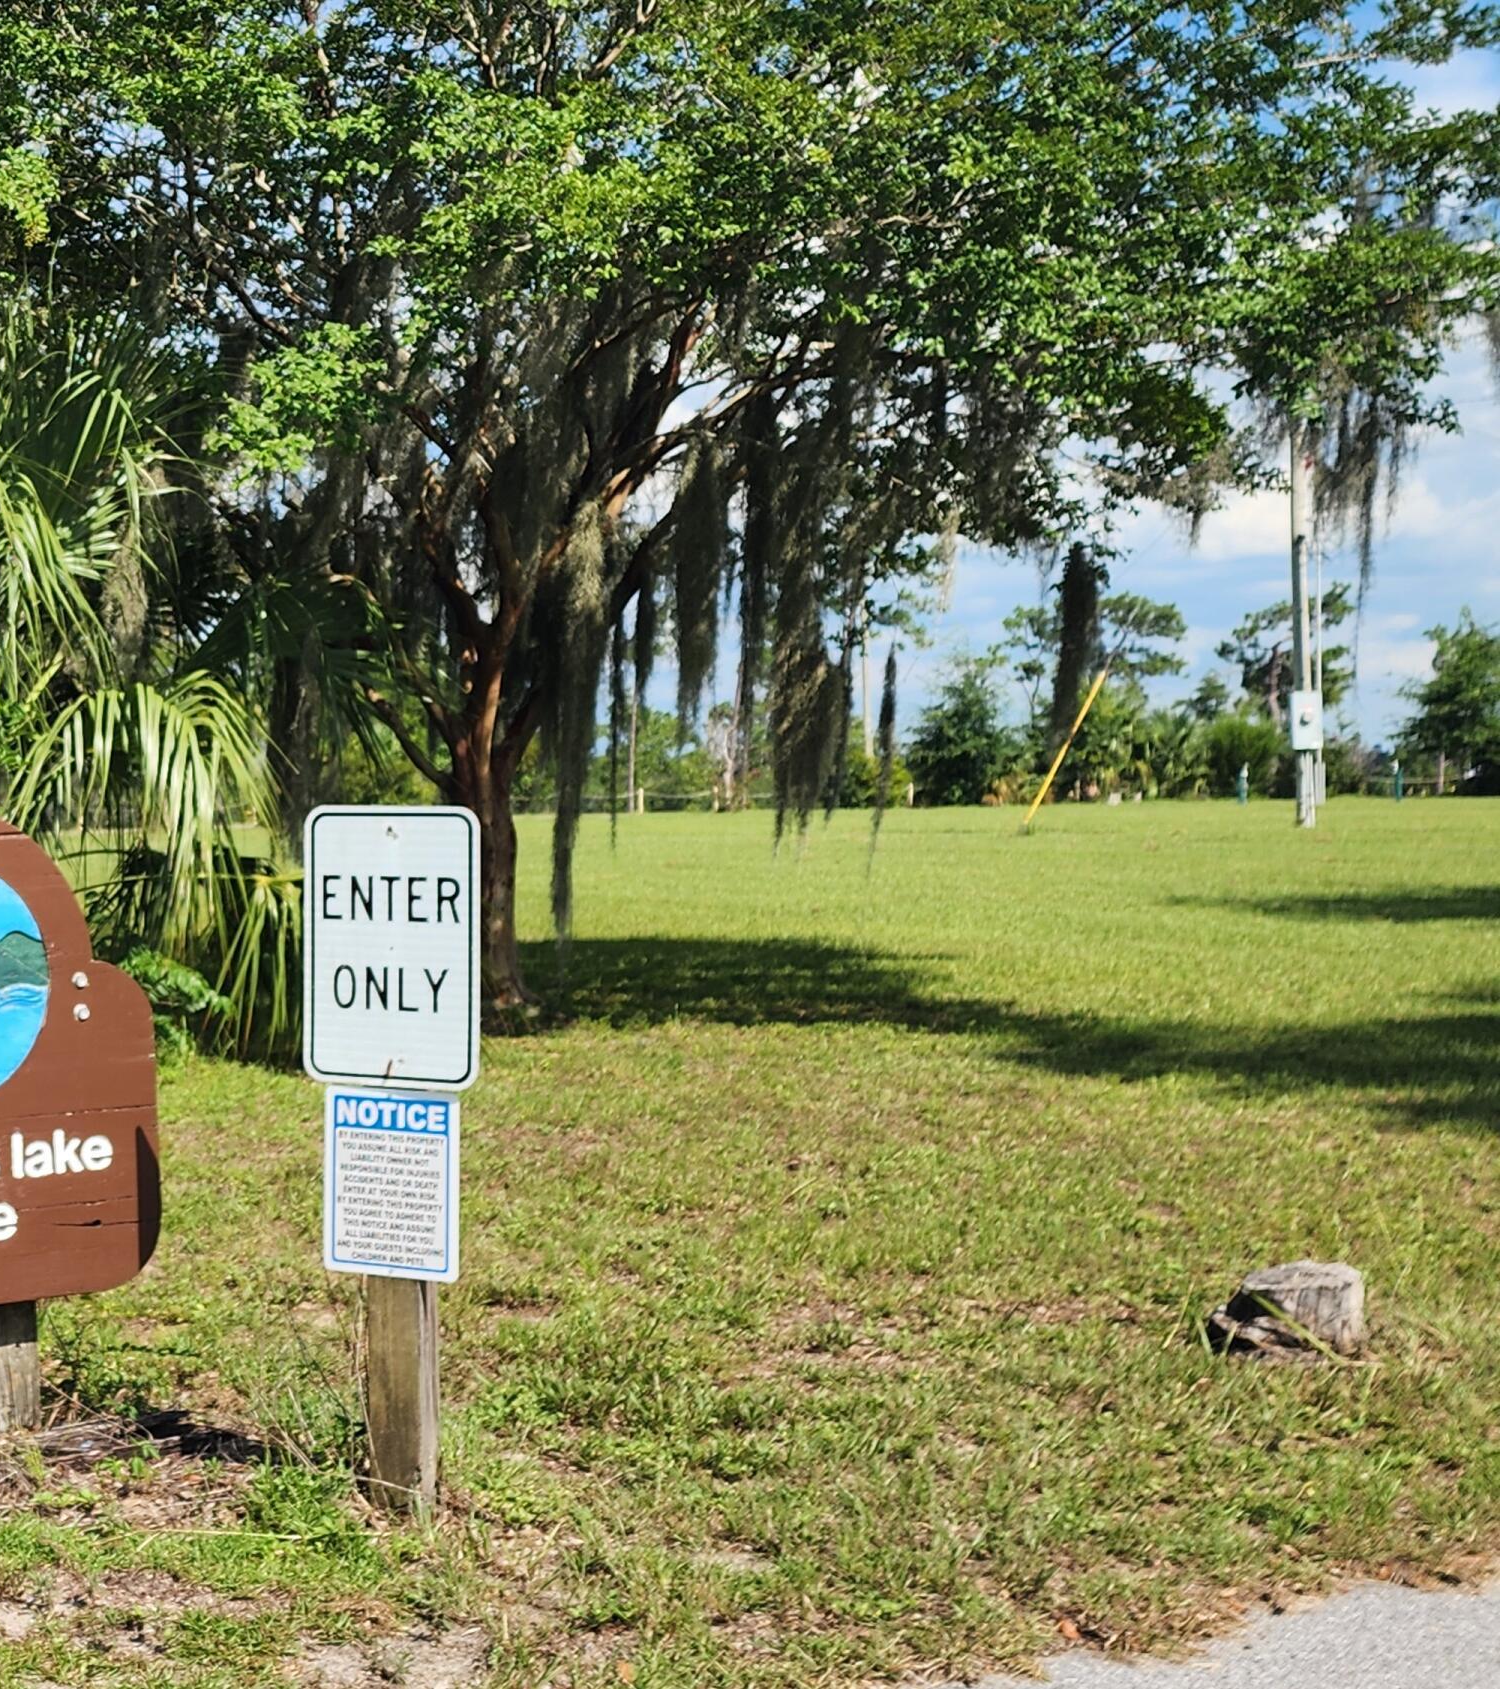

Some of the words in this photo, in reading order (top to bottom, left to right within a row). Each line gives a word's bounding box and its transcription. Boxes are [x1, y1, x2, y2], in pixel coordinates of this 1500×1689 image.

[322, 875, 460, 923] ENTER
[334, 965, 449, 1013] ONLY
[336, 1097, 447, 1132] NOTICE
[339, 1130, 347, 1138] BY
[350, 1131, 386, 1141] ENTERING
[388, 1134, 404, 1142] THIS
[407, 1136, 444, 1146] PROPERTY
[10, 1128, 114, 1179] lake
[359, 1143, 386, 1152] ASSUME
[424, 1149, 439, 1157] AND
[351, 1153, 385, 1162] LIABILITY
[387, 1156, 412, 1164] OWNER
[340, 1163, 387, 1174] RESPONSIBLE
[391, 1167, 404, 1175] FOR
[407, 1169, 440, 1178] INJURIES
[344, 1175, 383, 1185] ACCIDENTS
[386, 1178, 400, 1186] AND
[415, 1181, 438, 1189] DEATH
[380, 1189, 398, 1197] YOUR
[349, 1197, 384, 1207] ENTERING
[386, 1200, 402, 1208] THIS
[405, 1202, 442, 1212] PROPERTY
[360, 1209, 382, 1217] AGREE
[396, 1212, 424, 1222] ADHERE
[428, 1215, 436, 1223] TO
[343, 1218, 359, 1226] THIS
[362, 1219, 387, 1229] NOTICE
[406, 1224, 436, 1233] ASSUME
[360, 1231, 400, 1241] LIABILITIES
[420, 1237, 434, 1245] YOU
[375, 1244, 402, 1252] GUESTS
[405, 1247, 444, 1257] INCLUDING
[352, 1251, 387, 1260] CHILDREN
[390, 1255, 404, 1263] AND
[406, 1257, 424, 1265] PETS
